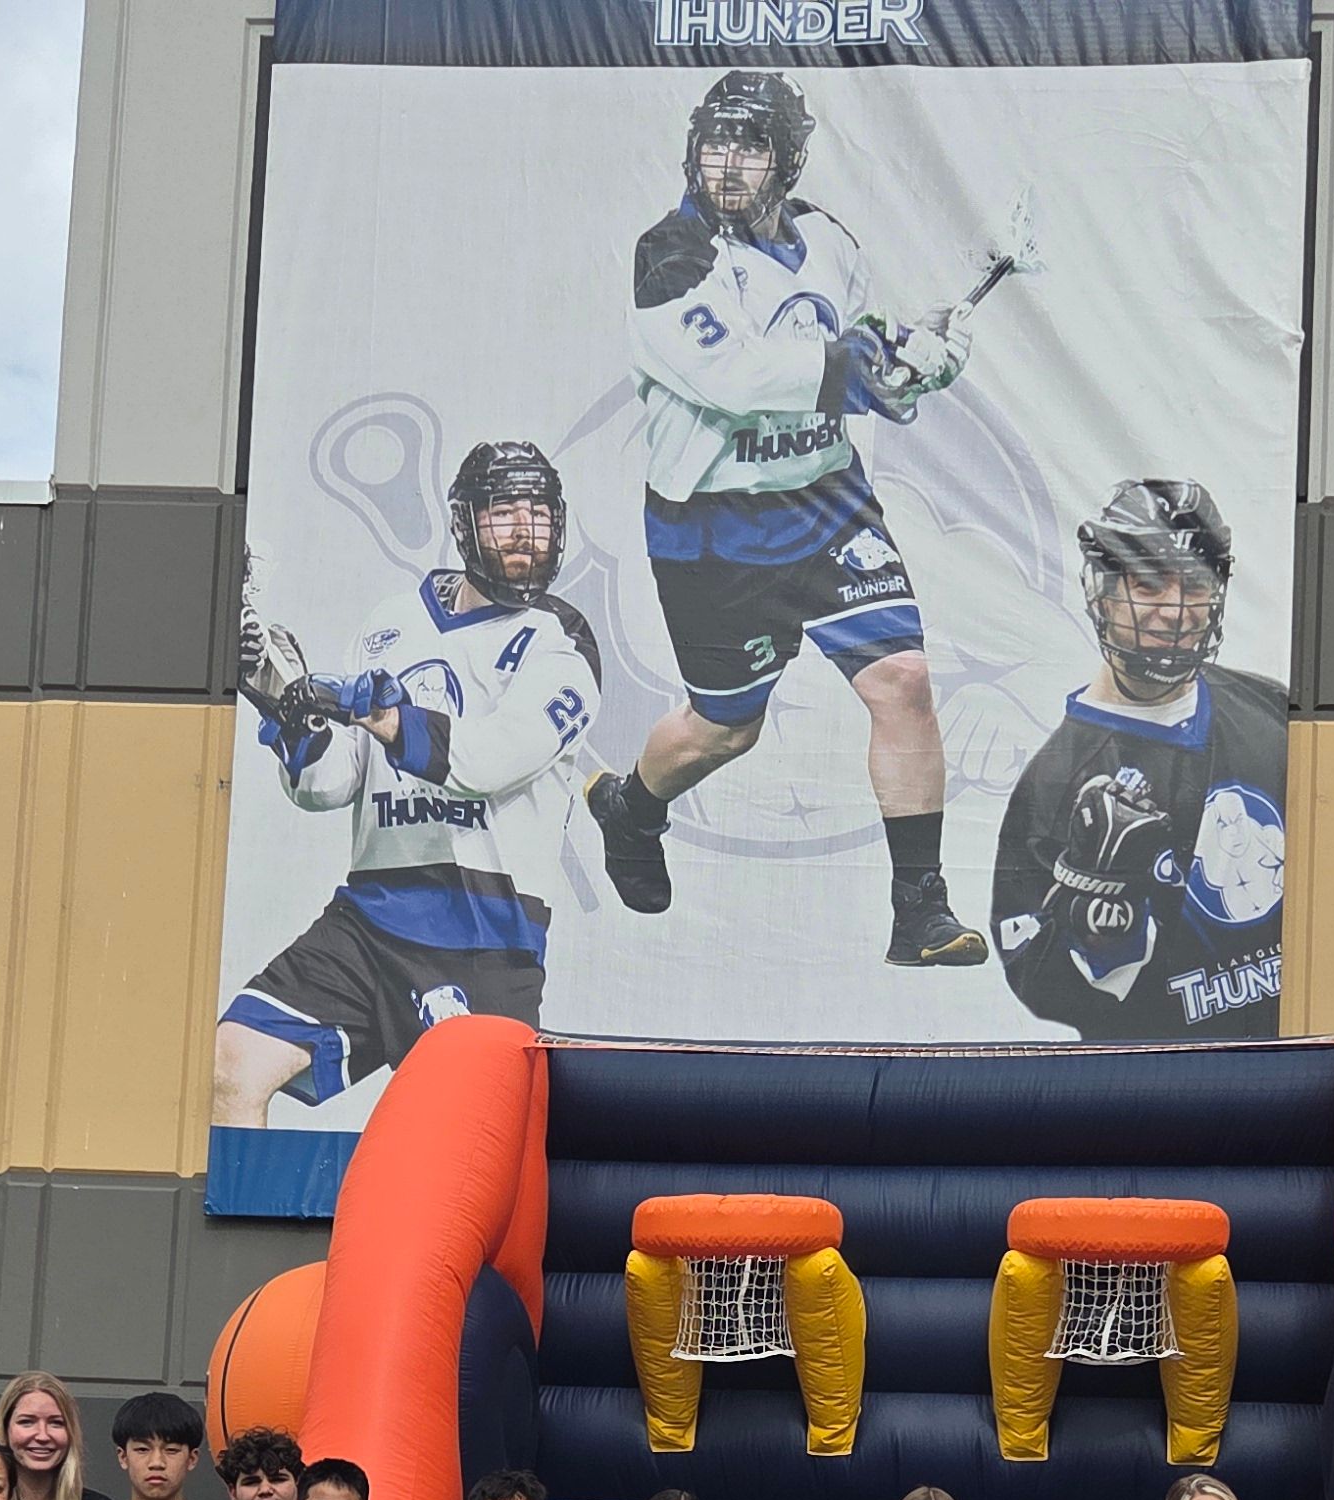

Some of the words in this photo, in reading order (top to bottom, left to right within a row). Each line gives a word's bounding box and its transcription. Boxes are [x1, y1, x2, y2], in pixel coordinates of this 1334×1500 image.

[681, 303, 729, 348] 3
[731, 418, 843, 462] THUNDER
[838, 575, 907, 602] THUNDER
[495, 626, 537, 673] A
[744, 635, 776, 671] 3
[372, 792, 489, 830] THUNDER
